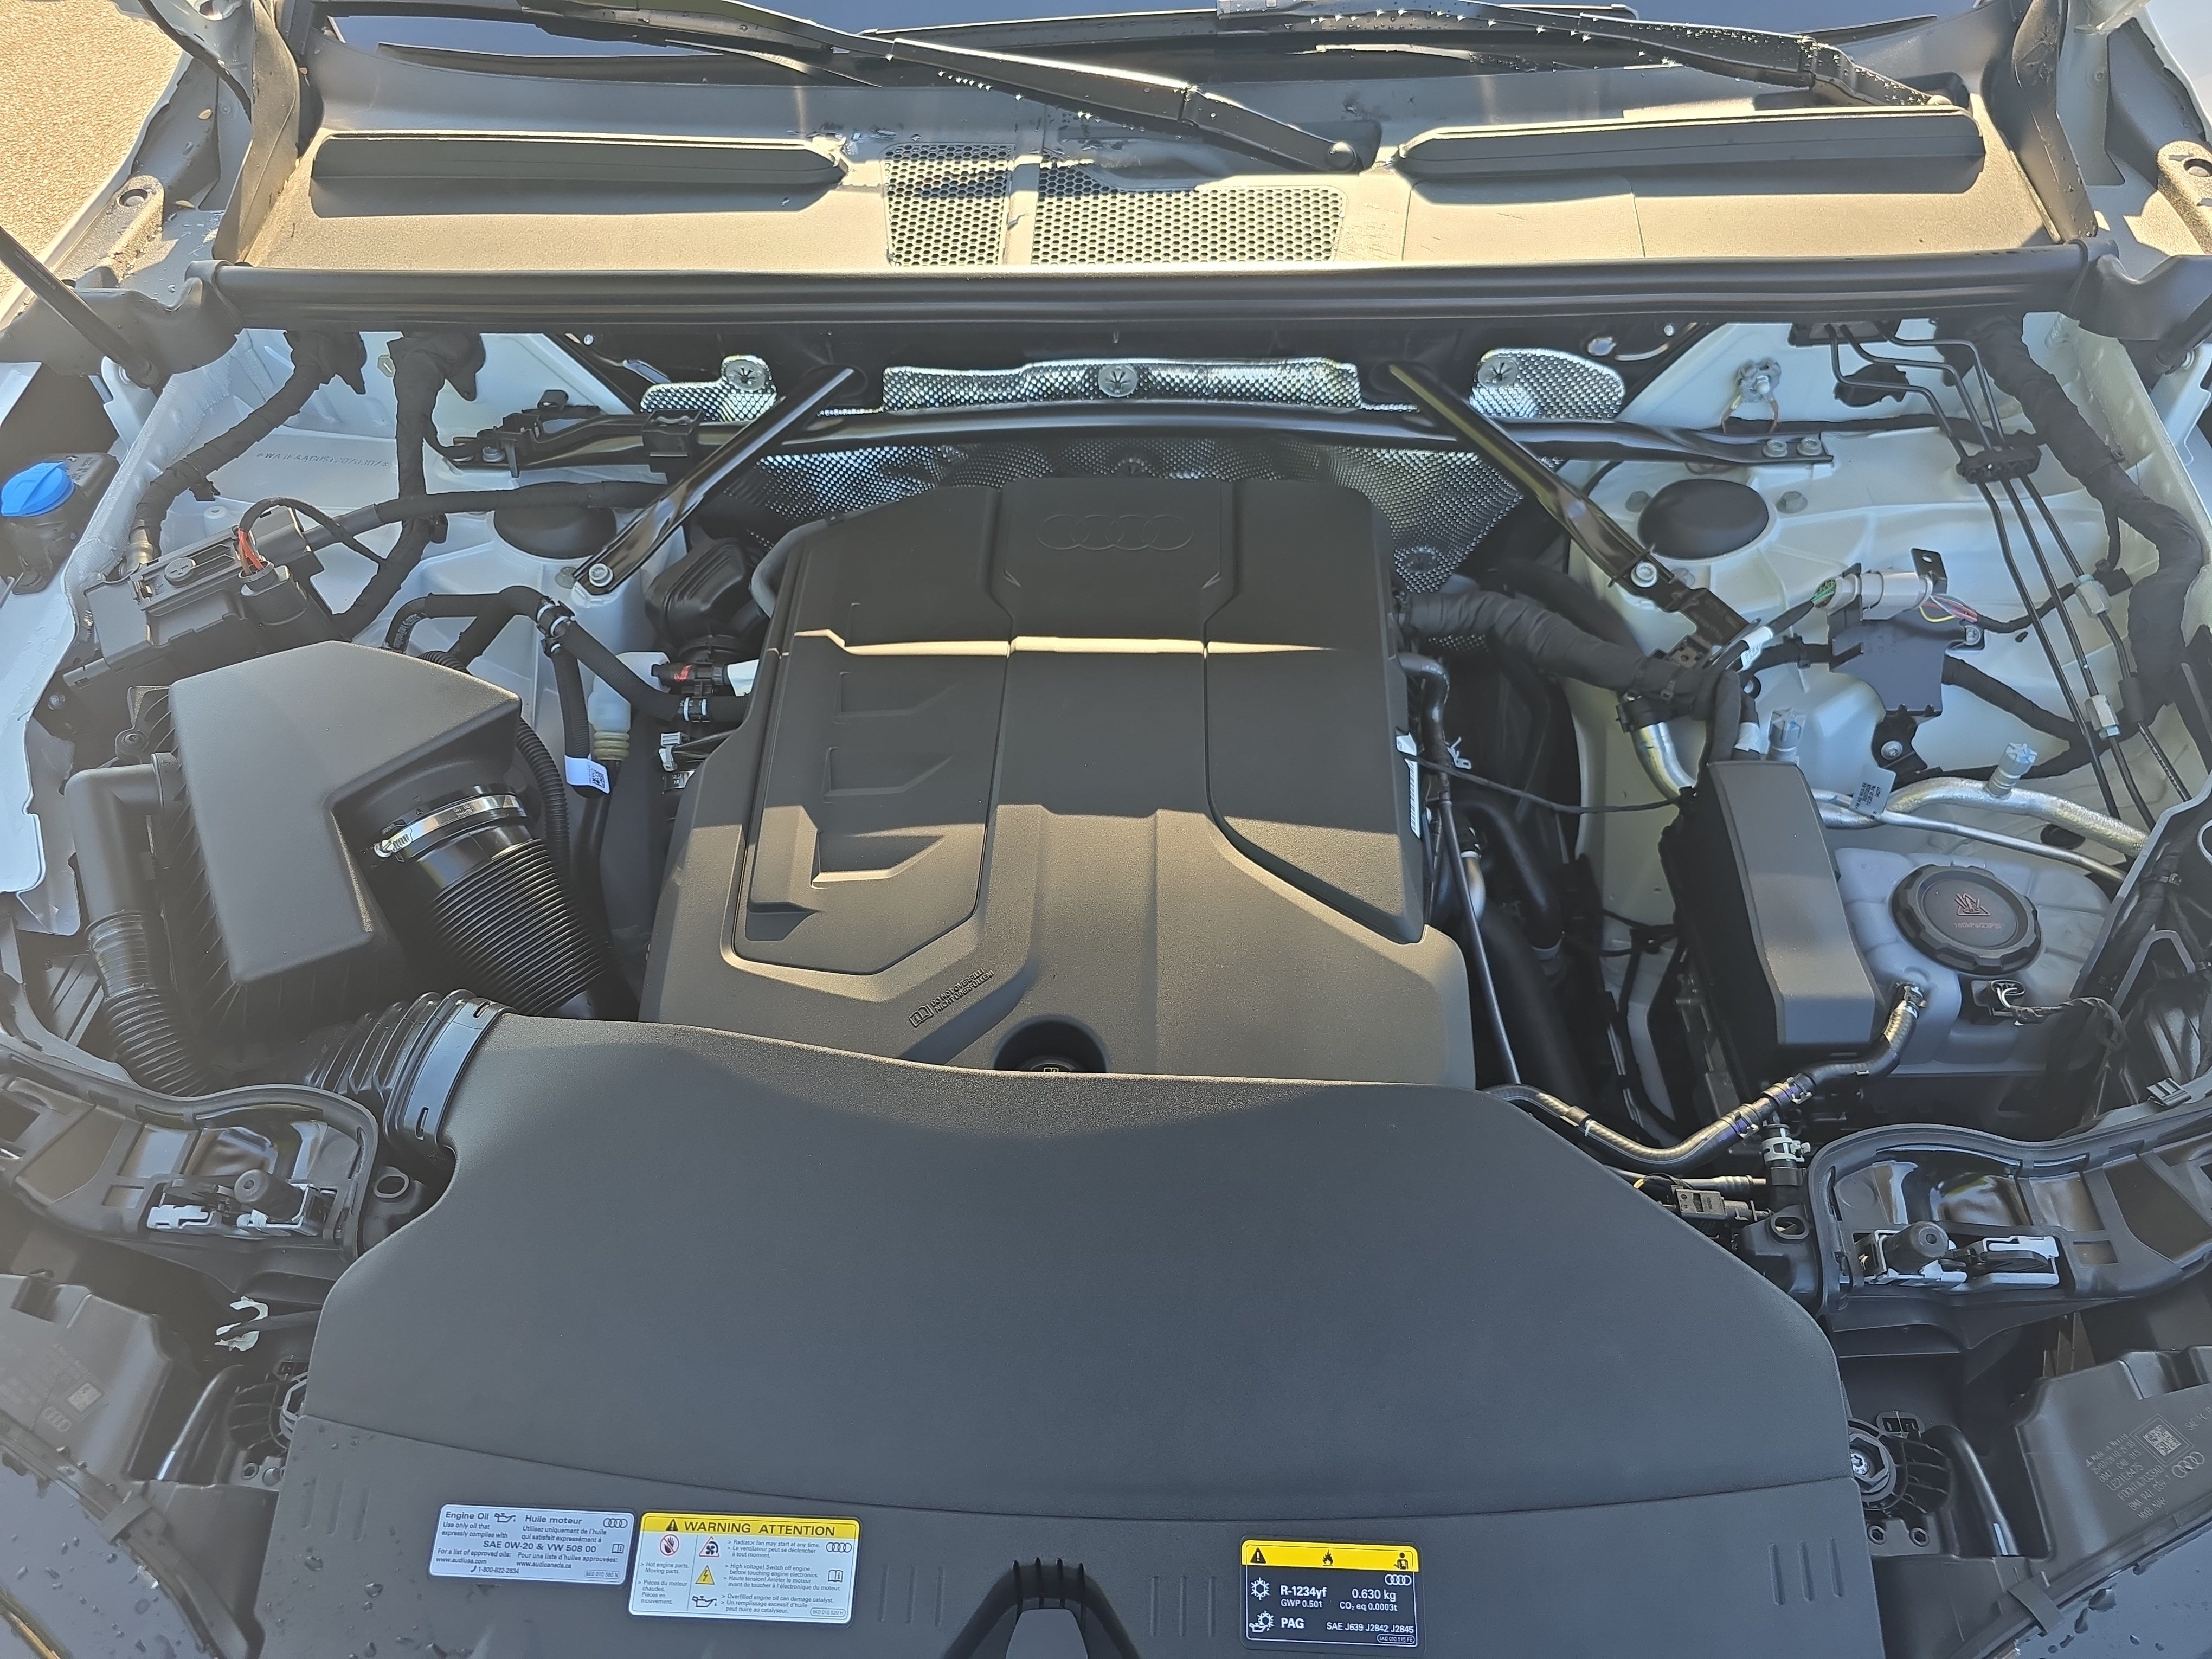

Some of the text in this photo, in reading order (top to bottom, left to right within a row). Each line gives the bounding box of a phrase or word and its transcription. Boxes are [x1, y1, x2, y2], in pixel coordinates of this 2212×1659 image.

[930, 996, 942, 1008] DO
[940, 987, 955, 999] NOT
[445, 1511, 475, 1520] Engine
[525, 1515, 582, 1525] Huile moteur
[544, 1526, 580, 1535] uniquement
[684, 1521, 835, 1536] WARNING ATTENTION
[556, 1535, 597, 1544] expressément
[504, 1541, 533, 1550] 0W-20
[547, 1543, 564, 1552] VW
[565, 1544, 583, 1552] 508
[516, 1561, 572, 1569] www.audicanada.ca
[730, 1563, 743, 1571] High
[1279, 1584, 1397, 1602] R-1234yf 0.630 kg
[1280, 1599, 1301, 1607] GWP
[1302, 1600, 1323, 1609] 0.501
[1356, 1603, 1367, 1612] eq
[1368, 1602, 1398, 1612] 0.0003t
[1281, 1617, 1414, 1634] PAG SAE J639 J2842 J2845
